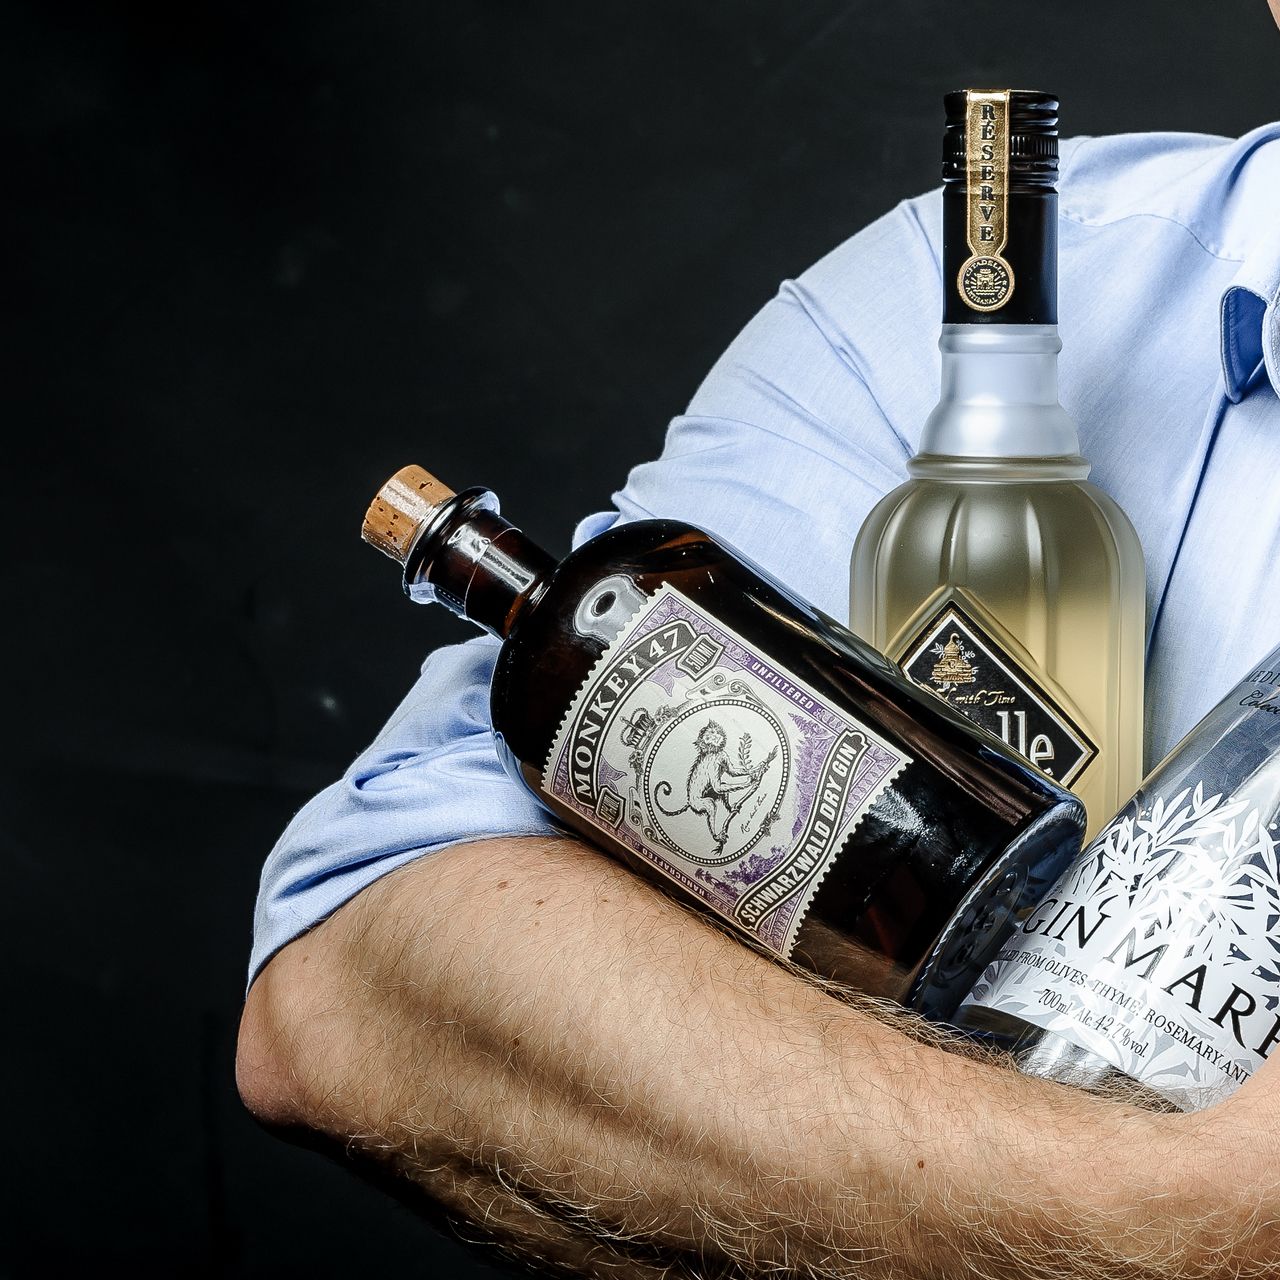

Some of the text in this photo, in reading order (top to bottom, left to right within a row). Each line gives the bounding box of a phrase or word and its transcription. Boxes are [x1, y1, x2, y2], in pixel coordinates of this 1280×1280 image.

[980, 104, 996, 241] RÉSERVE
[575, 627, 680, 801] MONKEY 47
[751, 662, 814, 710] UNFILTERED
[641, 847, 706, 897] HANDCRAFTED
[740, 742, 858, 924] SCHWARZWALD DRY GIN
[1022, 898, 1112, 950] GIN
[1018, 951, 1047, 970] FROM
[1143, 1008, 1224, 1066] ROSEMARY
[1130, 1039, 1151, 1058] vol.
